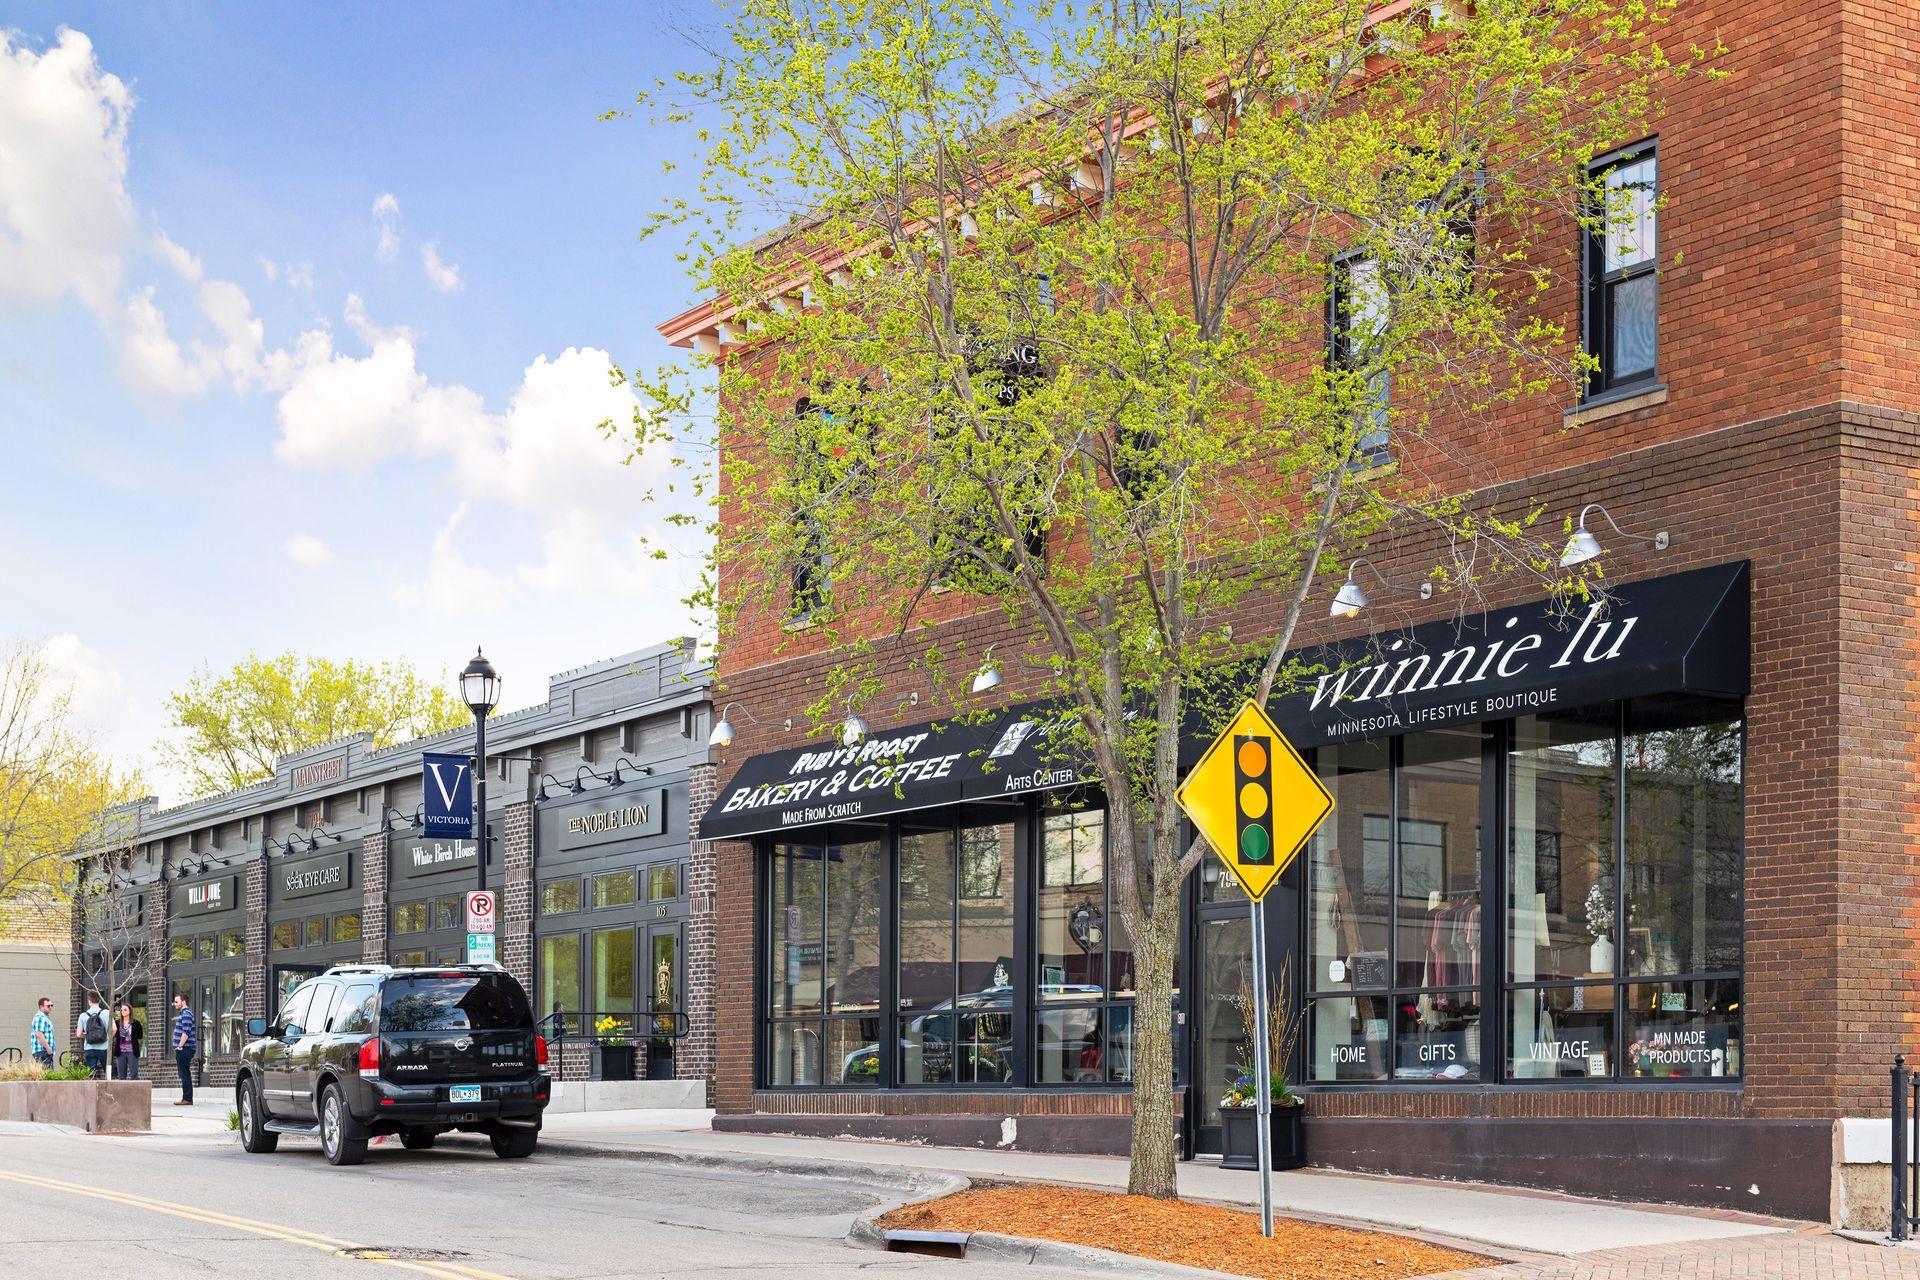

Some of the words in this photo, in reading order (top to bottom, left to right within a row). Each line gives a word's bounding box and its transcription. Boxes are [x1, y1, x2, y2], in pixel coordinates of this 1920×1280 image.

[1308, 616, 1542, 712] winnie
[1548, 600, 1639, 669] lu
[1326, 716, 1401, 737] MINNESOTA
[1408, 701, 1478, 724] LIFESTYLE
[1485, 688, 1558, 712] BOUTIQUE
[789, 743, 861, 775] RUBY'S
[857, 732, 929, 762] ROOST
[426, 762, 468, 812] V
[720, 777, 826, 814] BAKERY
[820, 769, 848, 797] &
[847, 751, 963, 793] COFFEE
[1004, 774, 1032, 792] ARTS
[427, 815, 470, 825] VICTORIA
[568, 818, 581, 832] THE
[581, 810, 619, 834] NOBLE
[620, 804, 649, 828] LION
[781, 811, 804, 826] MADE
[804, 807, 826, 821] FROM
[827, 801, 862, 818] SCRATCH
[412, 846, 433, 867] White
[434, 843, 453, 863] Birch
[454, 839, 477, 859] House
[304, 870, 319, 888] EYE
[319, 866, 340, 885] CARE
[656, 905, 667, 917] 105
[469, 937, 476, 948] 2
[292, 974, 304, 982] 103
[1653, 1031, 1672, 1045] MN
[1674, 1030, 1706, 1044] MADE
[1330, 1046, 1366, 1063] HOME
[1419, 1043, 1456, 1061] GIFTS
[1528, 1040, 1590, 1060] VINTAGE
[1649, 1048, 1711, 1064] PRODUCTS
